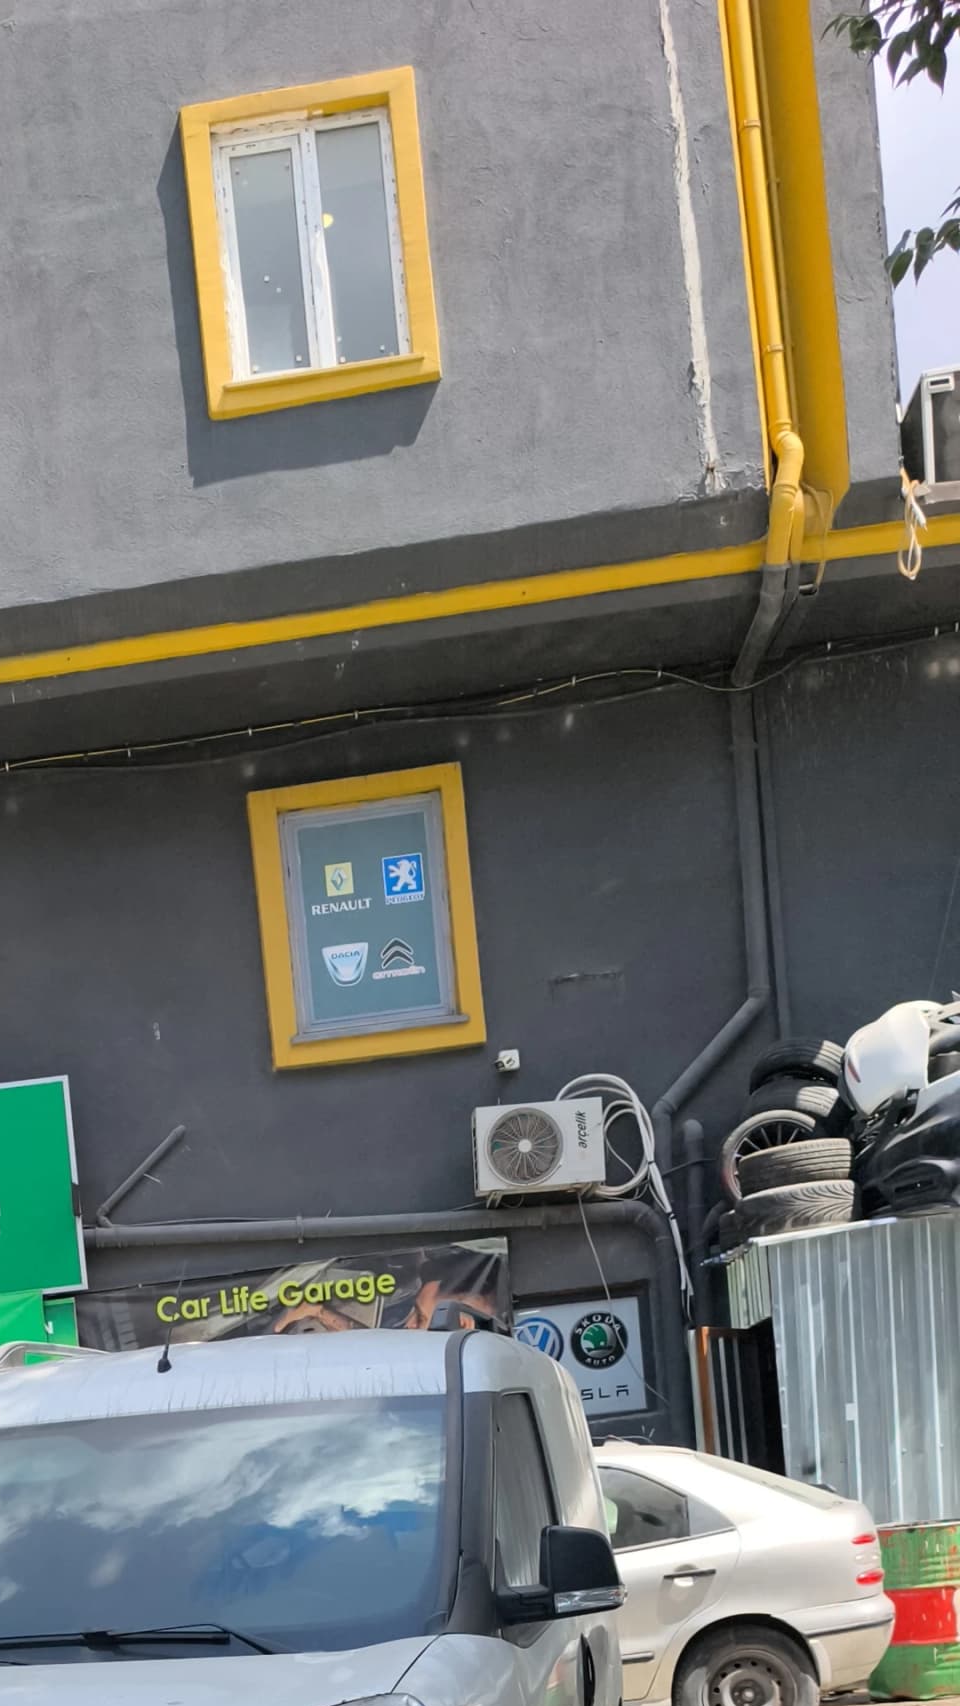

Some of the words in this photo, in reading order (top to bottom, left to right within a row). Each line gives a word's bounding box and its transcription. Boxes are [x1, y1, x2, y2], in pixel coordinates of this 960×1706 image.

[311, 898, 372, 916] RENAULT
[575, 1110, 589, 1149] arçelik
[155, 1296, 211, 1323] Car
[219, 1286, 269, 1316] Life
[277, 1273, 396, 1308] Garage
[584, 1354, 617, 1366] AUTO
[580, 1383, 630, 1401] SLA
